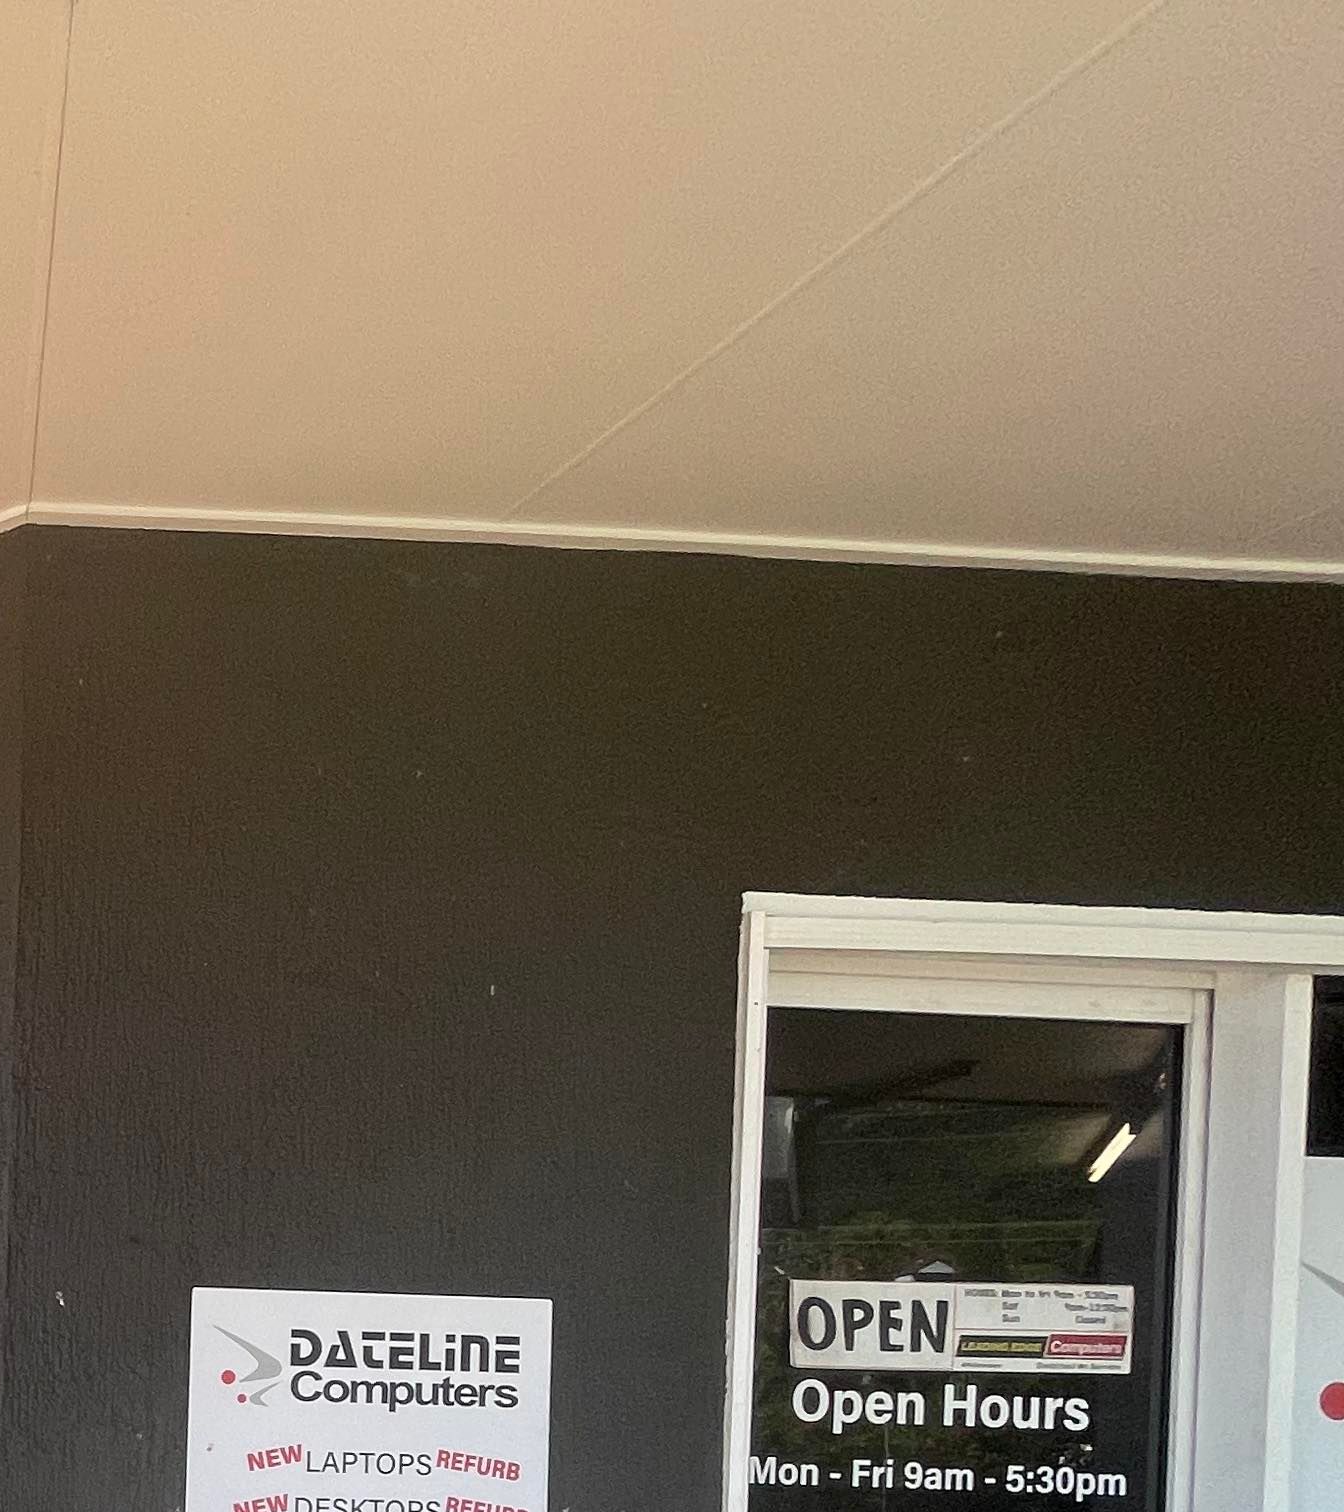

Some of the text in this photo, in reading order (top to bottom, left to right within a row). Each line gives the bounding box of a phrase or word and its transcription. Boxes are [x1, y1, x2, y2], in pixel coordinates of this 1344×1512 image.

[796, 1295, 949, 1353] OPEN
[290, 1371, 519, 1413] Computers
[792, 1377, 1090, 1435] Open Hours
[247, 1443, 522, 1482] NEW LAPTOPS REFURB
[749, 1456, 819, 1486] Mon
[852, 1459, 894, 1489] Fri
[904, 1461, 974, 1491] 9am
[1005, 1465, 1128, 1502] 5:30pm
